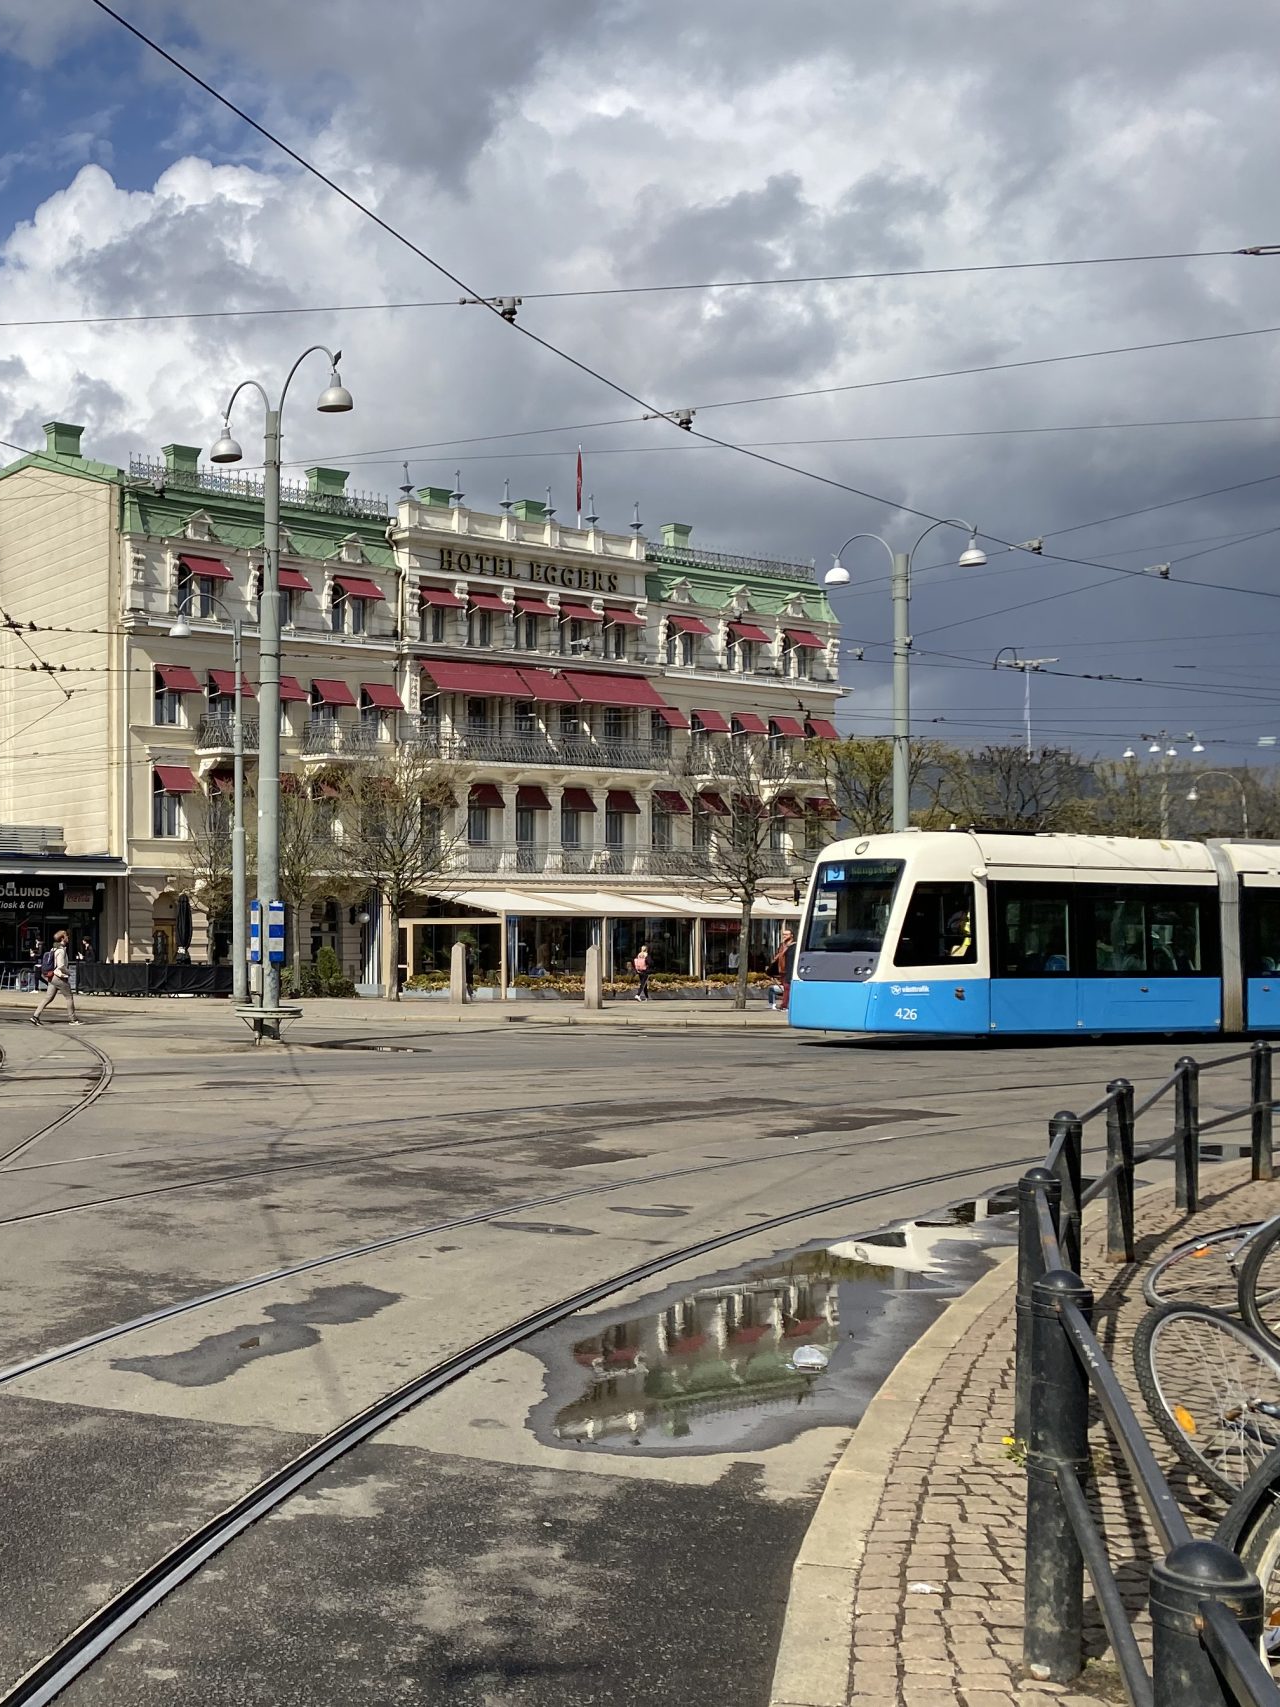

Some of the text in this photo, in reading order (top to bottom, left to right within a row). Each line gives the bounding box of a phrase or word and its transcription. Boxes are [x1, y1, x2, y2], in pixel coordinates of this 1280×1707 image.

[439, 548, 619, 593] HOTEL EGGERS
[833, 864, 840, 879] 9
[19, 901, 25, 909] &
[27, 901, 44, 909] Grill
[894, 1007, 918, 1021] 426
